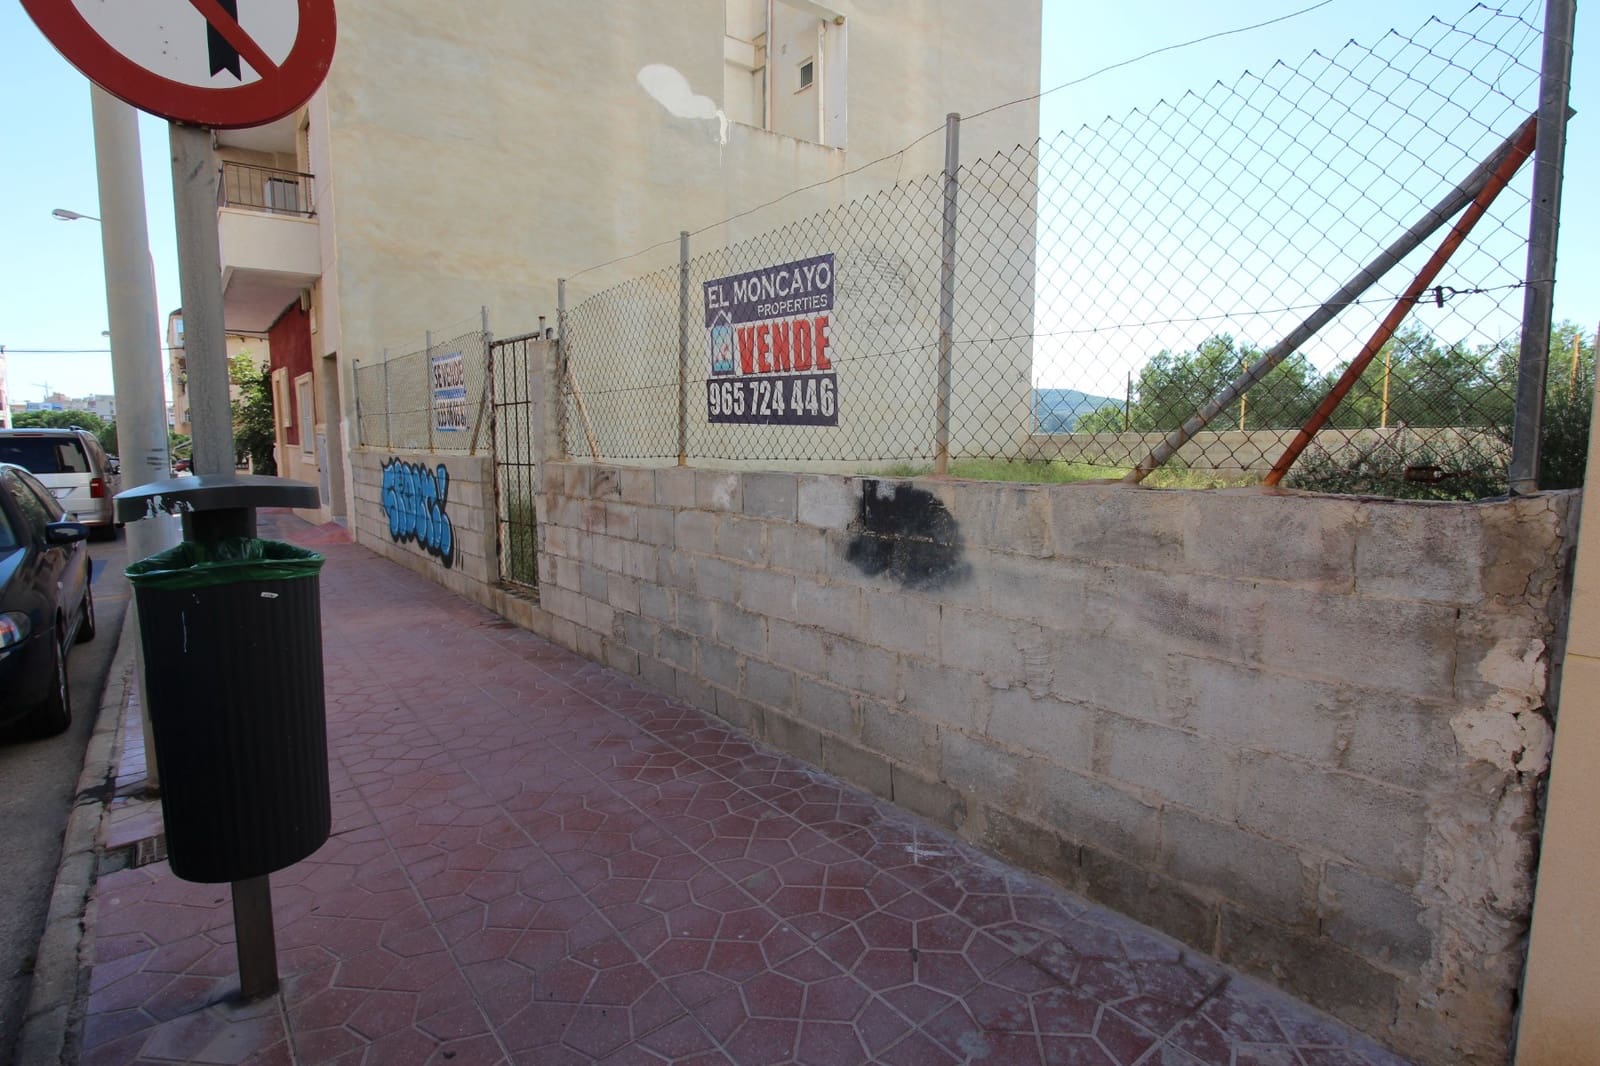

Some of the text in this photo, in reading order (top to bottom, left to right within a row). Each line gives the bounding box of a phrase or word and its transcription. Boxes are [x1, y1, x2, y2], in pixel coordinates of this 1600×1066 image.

[708, 262, 831, 309] EL MONCAYO
[757, 294, 828, 317] PROPERTIES
[737, 315, 832, 375] VENDE
[709, 378, 835, 416] 965 724 446
